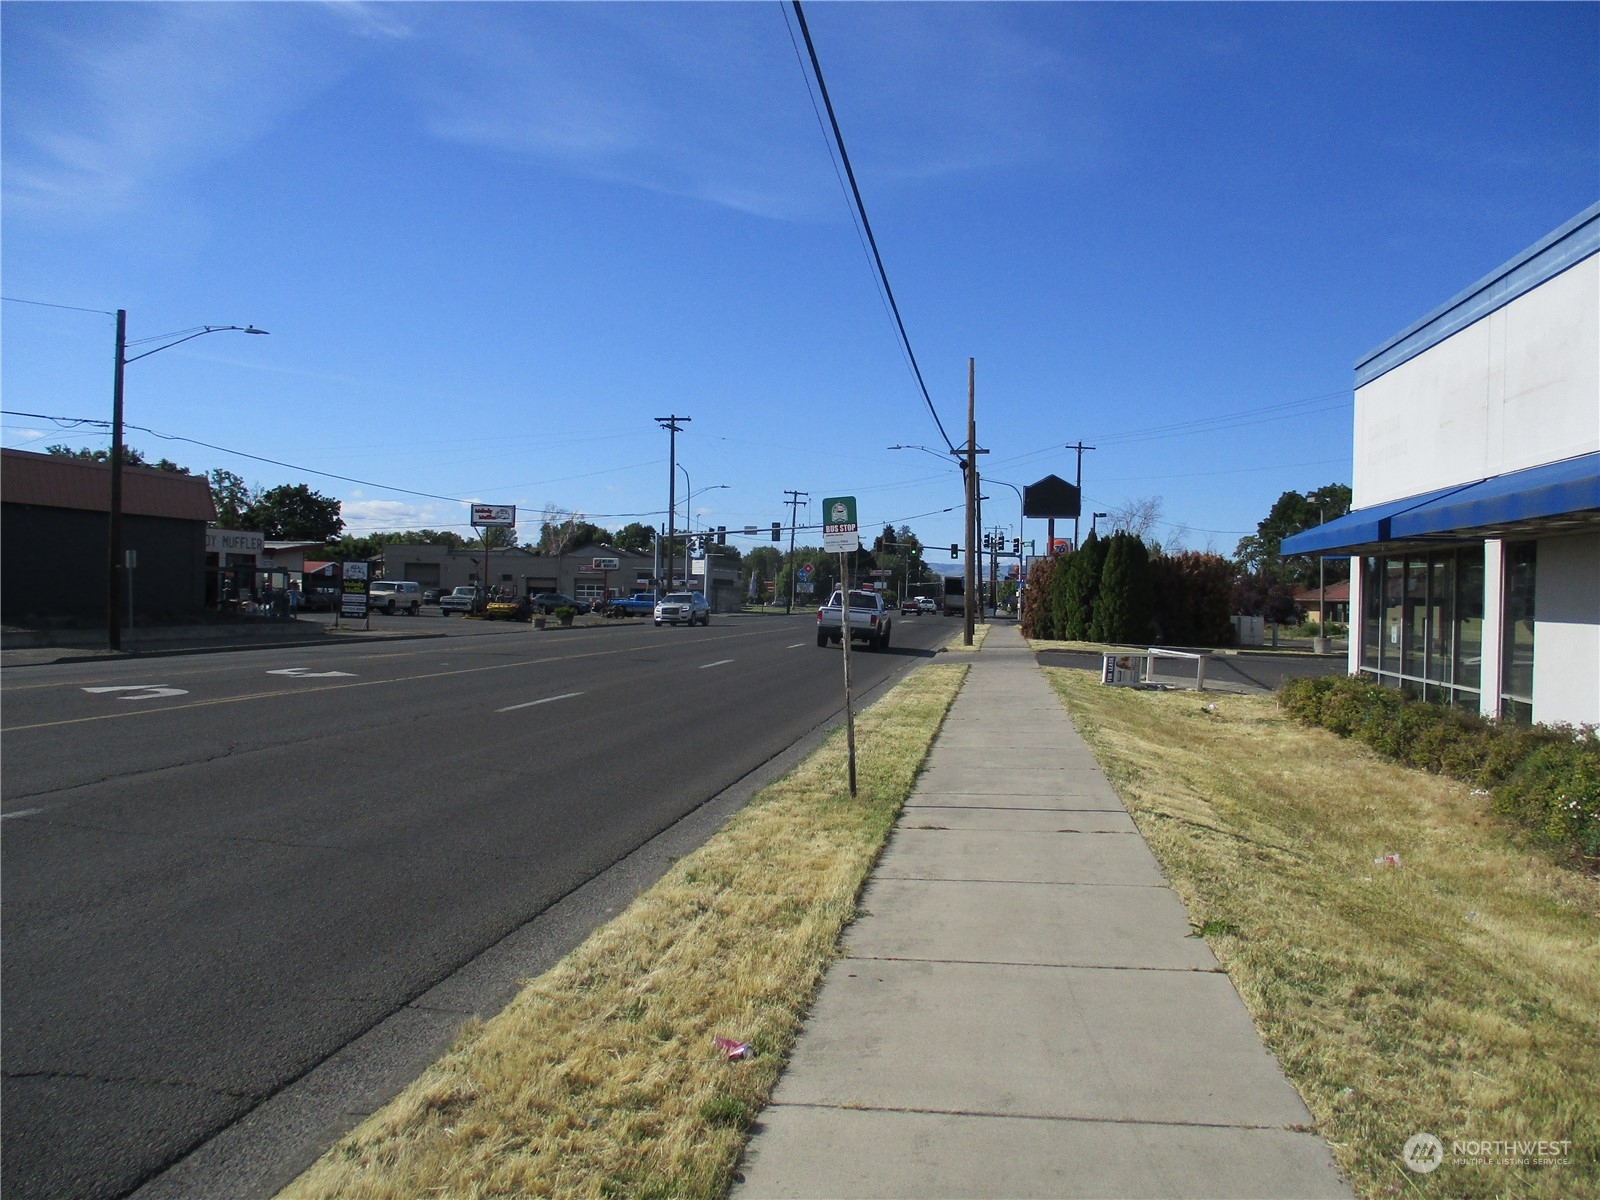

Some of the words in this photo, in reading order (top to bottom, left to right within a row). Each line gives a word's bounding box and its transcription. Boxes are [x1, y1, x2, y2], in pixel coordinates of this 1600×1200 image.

[840, 524, 856, 532] STOP
[222, 535, 262, 550] MUFFLER
[1055, 544, 1066, 553] 76
